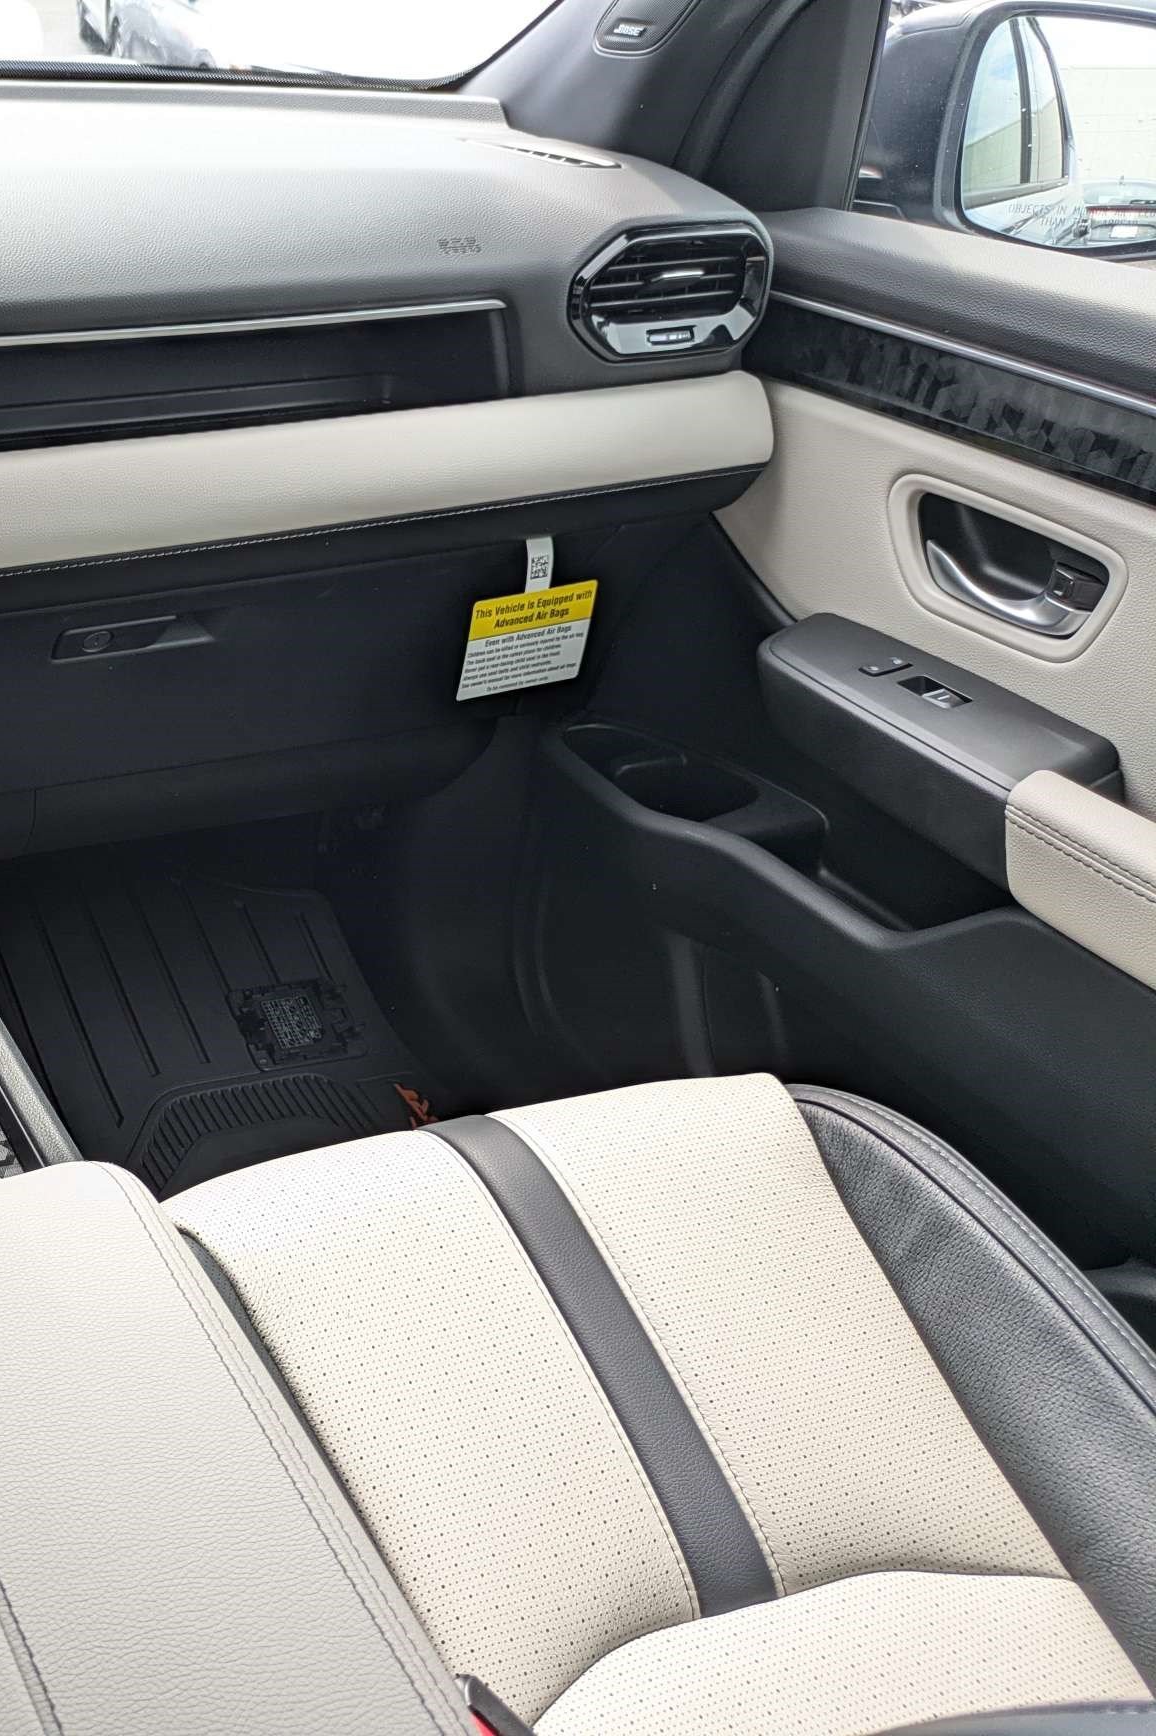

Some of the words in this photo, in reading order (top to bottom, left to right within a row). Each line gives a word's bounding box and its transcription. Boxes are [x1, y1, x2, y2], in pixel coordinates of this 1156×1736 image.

[475, 608, 493, 619] This
[495, 604, 525, 616] Vehicle
[526, 601, 535, 609] is
[536, 594, 574, 608] Equipped
[575, 589, 593, 600] with
[494, 615, 534, 629] Advanced
[535, 610, 548, 620] Air
[549, 607, 570, 619] Bags
[515, 630, 545, 641] Advanced
[546, 627, 556, 635] Air
[557, 625, 572, 634] Bags
